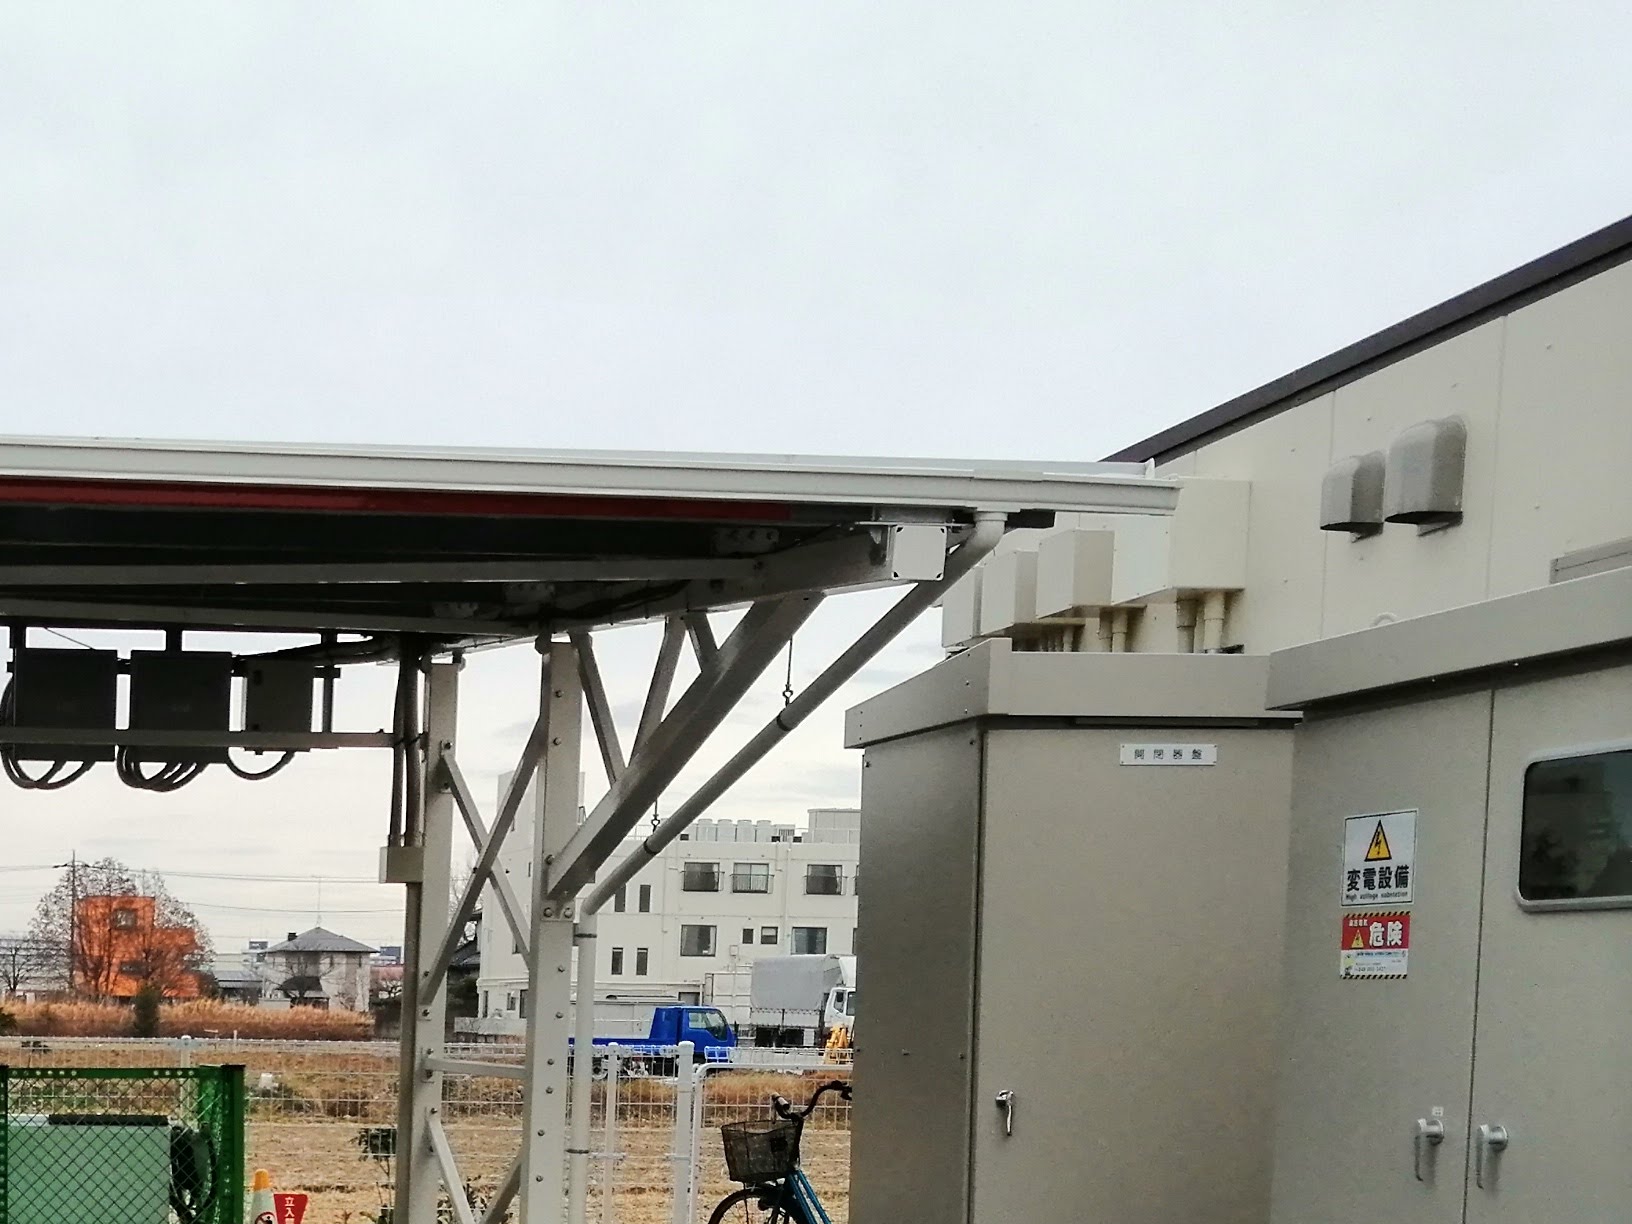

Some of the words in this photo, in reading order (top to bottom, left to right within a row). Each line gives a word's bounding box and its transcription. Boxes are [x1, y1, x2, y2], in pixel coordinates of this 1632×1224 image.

[1347, 864, 1409, 892] 変電設備
[1369, 921, 1403, 947] 危険
